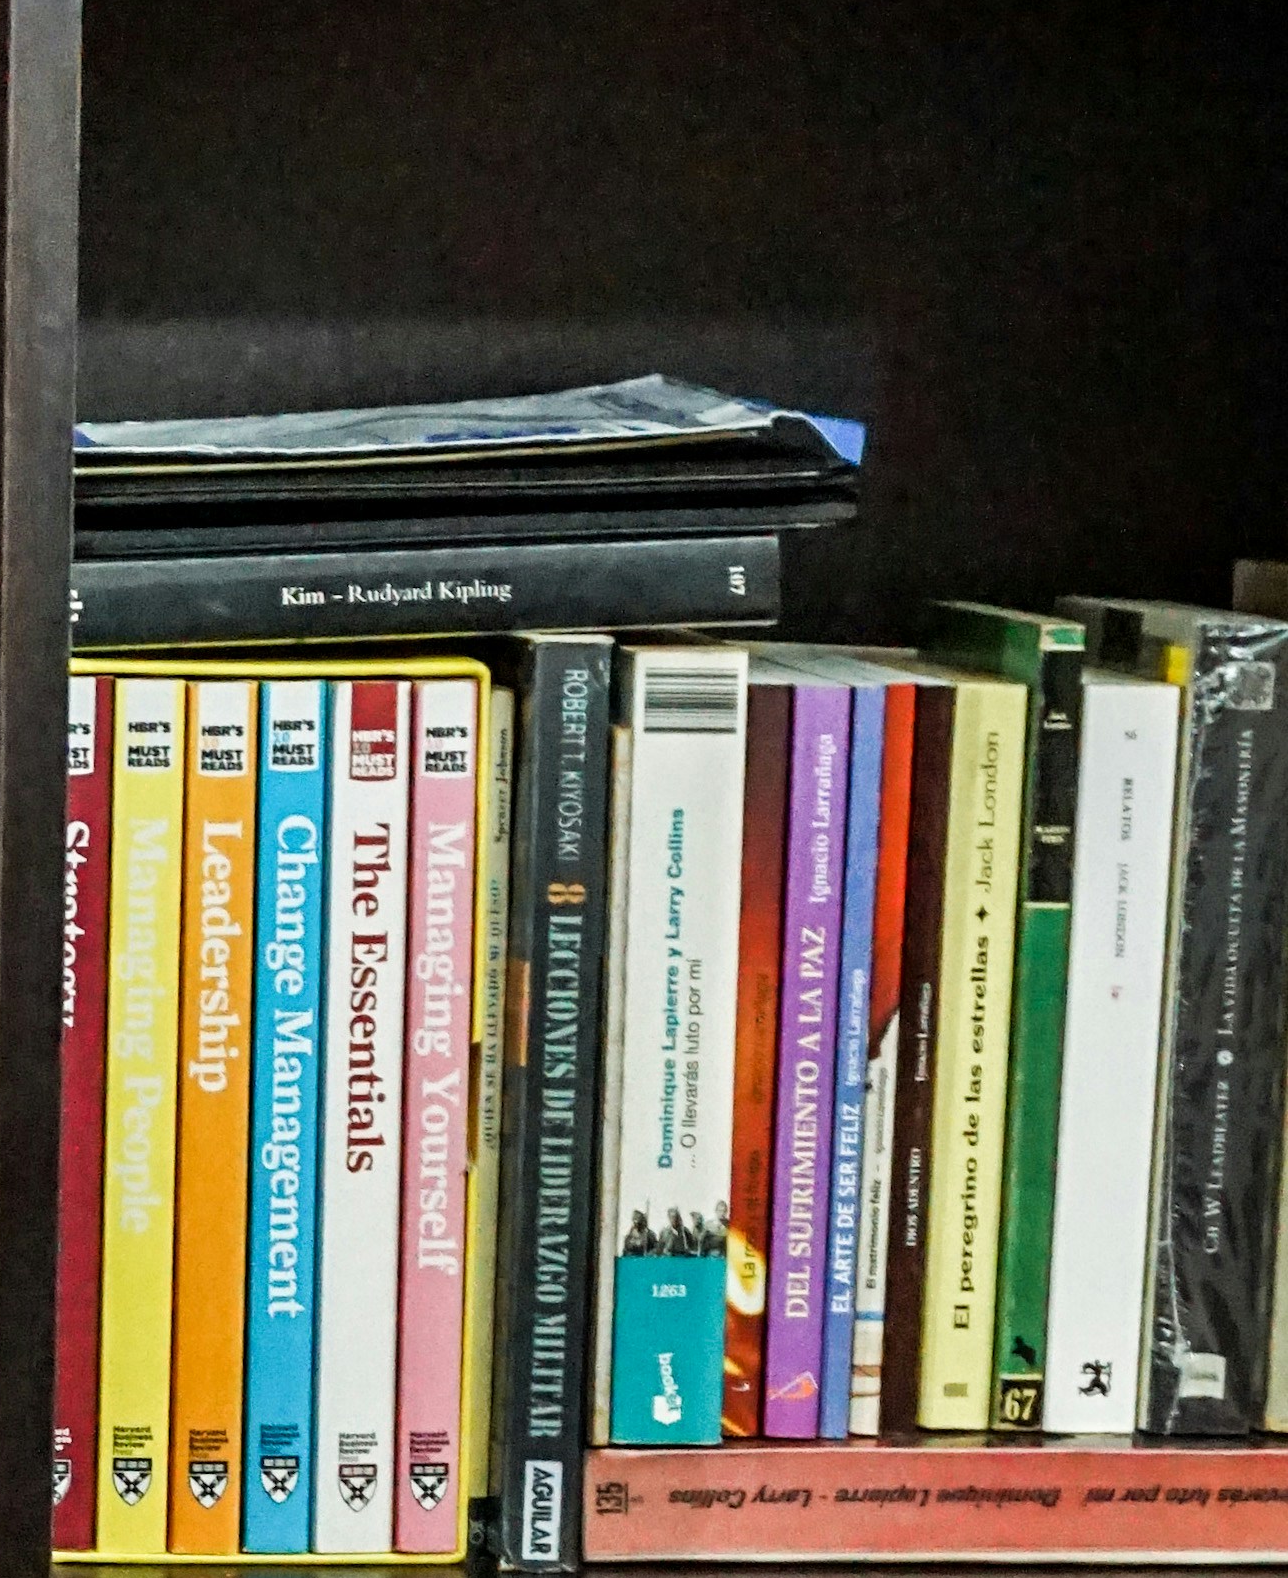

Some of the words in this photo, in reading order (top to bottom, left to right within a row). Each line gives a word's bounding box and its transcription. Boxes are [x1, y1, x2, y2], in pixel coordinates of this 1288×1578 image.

[281, 586, 326, 606] Kim
[347, 580, 433, 606] Rudyard
[437, 578, 513, 605] Kipling
[188, 820, 243, 1094] Leadership
[267, 814, 318, 995] Change
[351, 822, 392, 917] The
[413, 820, 465, 1057] Managing
[262, 1009, 313, 1317] Management
[345, 931, 388, 1174] Essentials
[418, 1067, 461, 1274] Yourself
